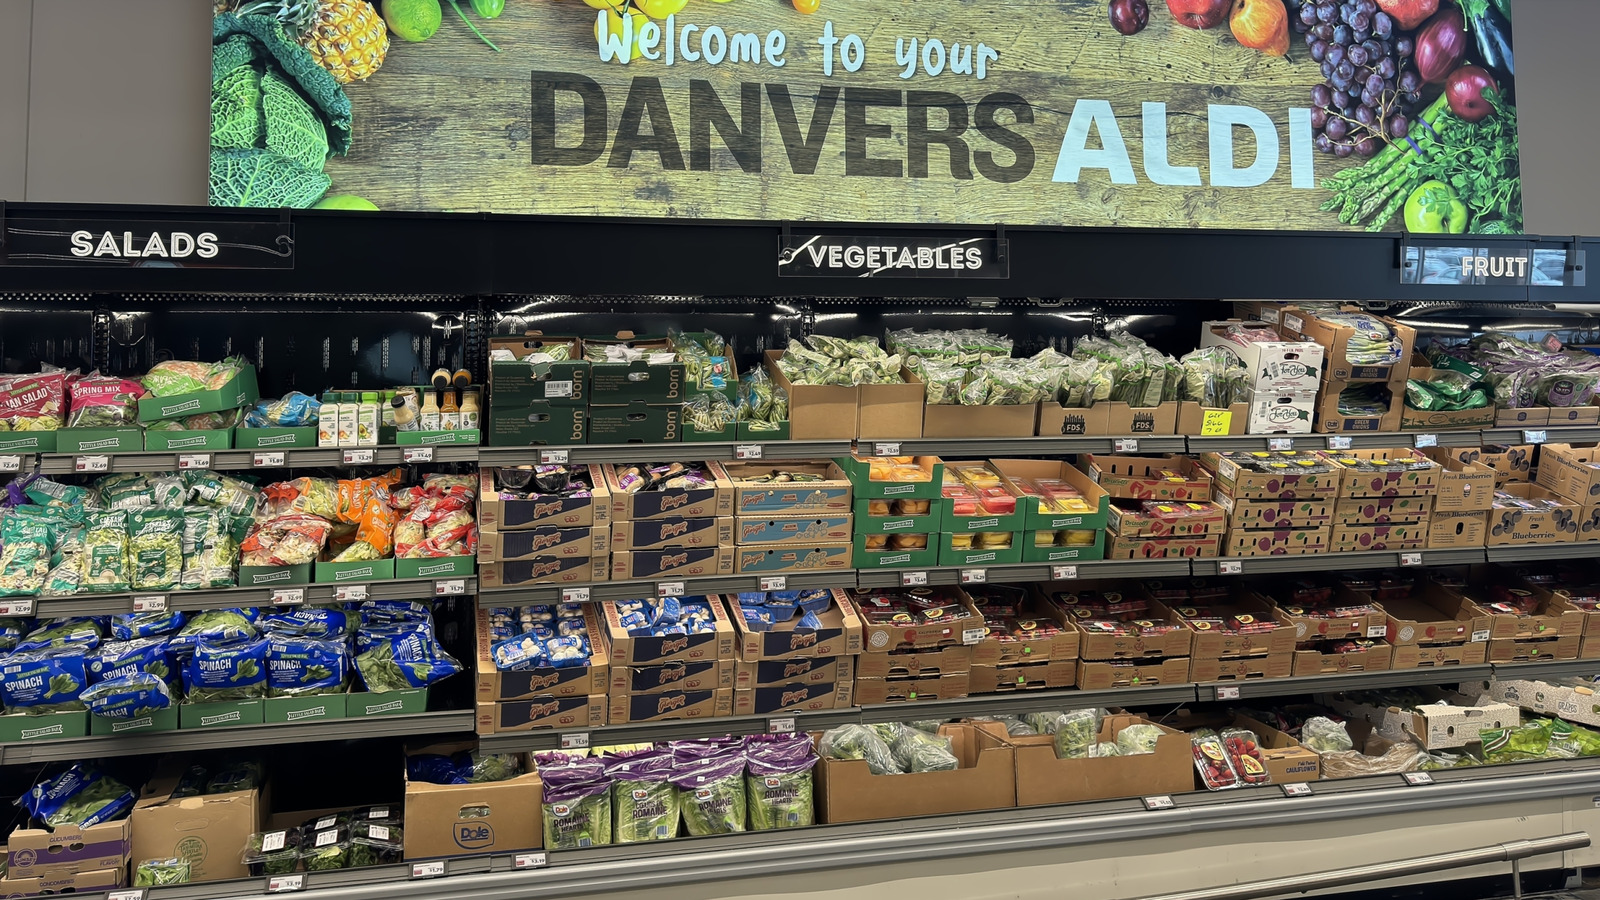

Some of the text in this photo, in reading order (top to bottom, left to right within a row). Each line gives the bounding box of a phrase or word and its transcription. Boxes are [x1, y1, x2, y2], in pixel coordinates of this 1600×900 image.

[597, 10, 998, 79] Welcome to your
[531, 70, 1315, 189] DANVERS ALDI
[70, 231, 219, 258] SALADS
[807, 246, 982, 270] VEGETABLES
[1461, 256, 1528, 277] FRUIT
[74, 385, 121, 398] SPRING MIX
[570, 369, 583, 401] born
[666, 369, 679, 399] born
[23, 387, 48, 404] SALAD
[570, 410, 583, 441] born
[663, 411, 677, 441] born
[1544, 450, 1589, 475] Fresh Blueberries
[1512, 531, 1556, 540] Blueberries
[293, 610, 328, 620] SPINACH
[409, 632, 424, 662] SPINACH
[102, 663, 138, 681] SPINACH
[199, 658, 232, 671] SPINACH
[269, 658, 302, 670] SPINACH
[5, 676, 43, 693] SPINACH
[1286, 765, 1316, 773] CAULIFLOWER
[46, 773, 76, 799] SPINACH
[765, 789, 799, 798] ROMAINE
[698, 797, 732, 811] ROMAINE
[553, 812, 590, 828] ROMAINE
[632, 807, 667, 819] ROMAINE
[460, 826, 490, 841] Dole
[561, 823, 584, 832] HEARTS
[40, 879, 74, 887] CONCOMBRES
